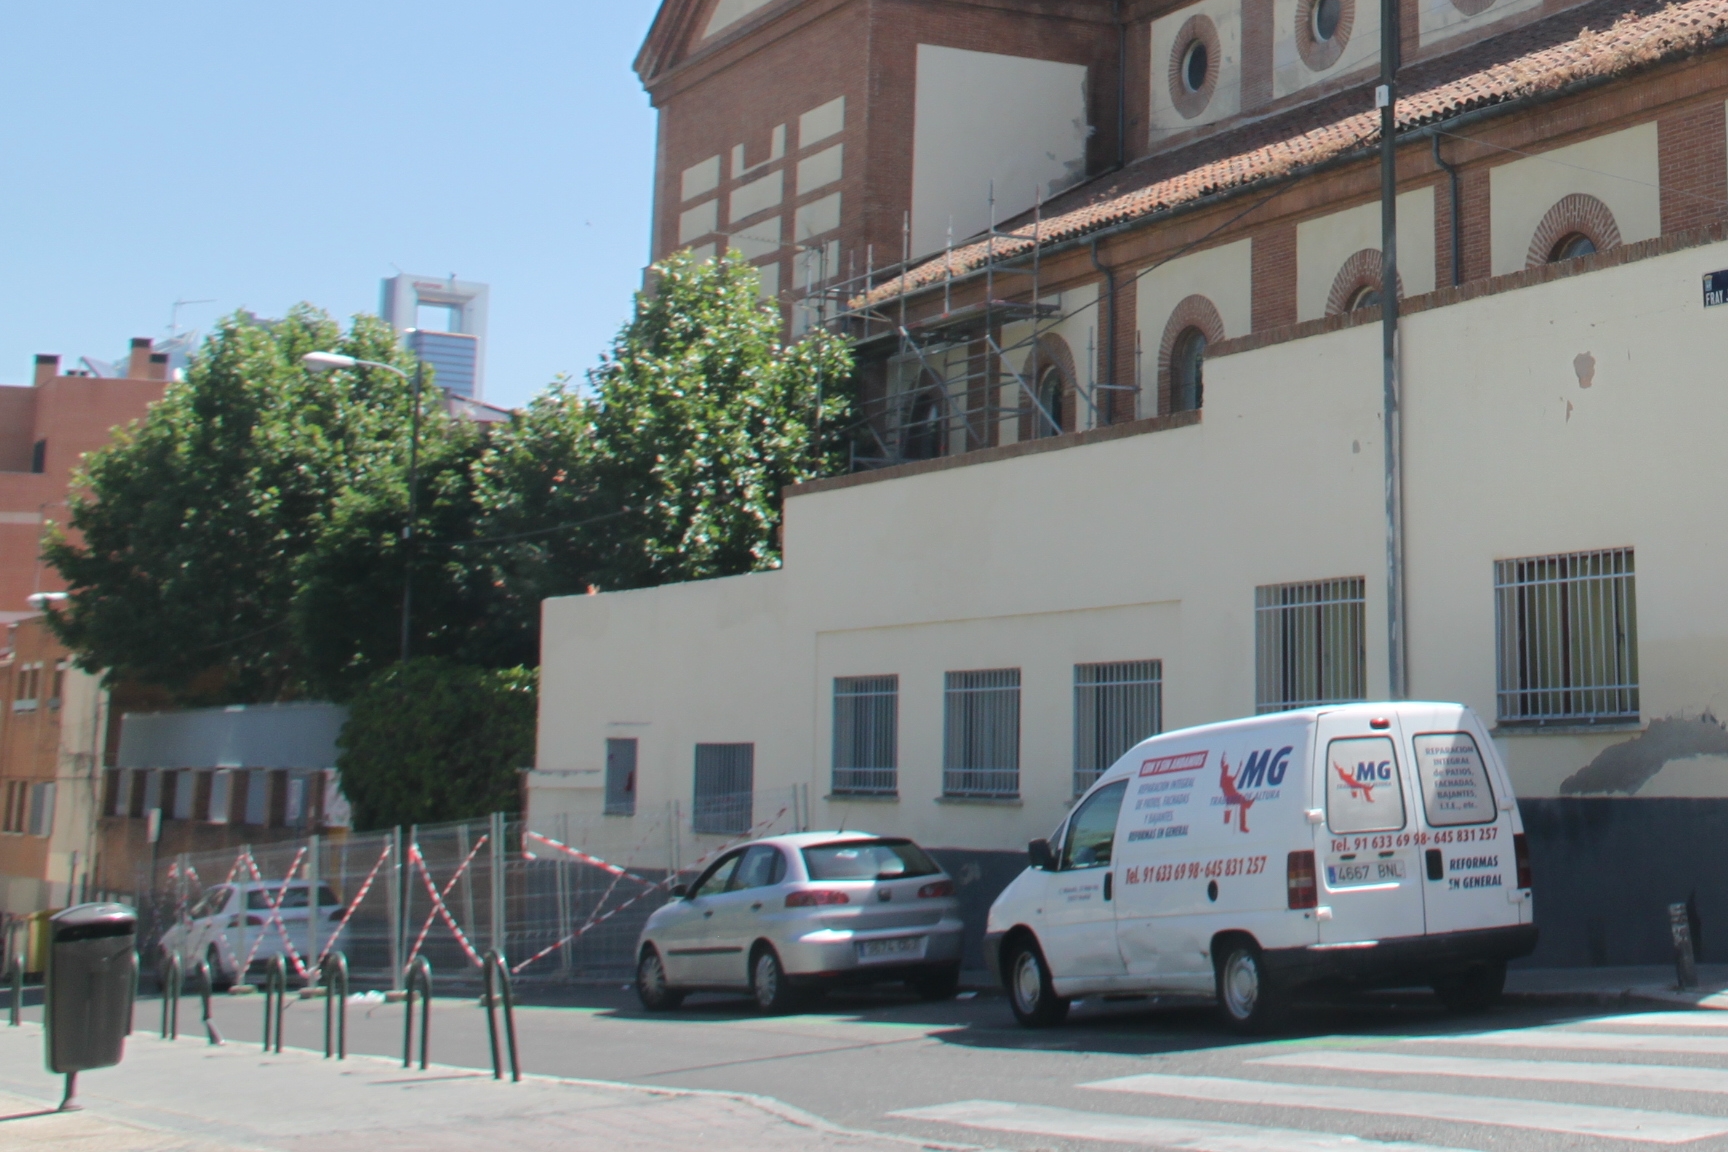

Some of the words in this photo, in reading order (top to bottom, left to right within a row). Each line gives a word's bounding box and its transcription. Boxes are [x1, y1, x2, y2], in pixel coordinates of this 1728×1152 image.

[1706, 290, 1723, 305] FRAY
[1237, 746, 1294, 789] MG
[1356, 761, 1391, 780] MG
[1331, 836, 1350, 852] Tel.
[1354, 836, 1368, 850] 91
[1371, 835, 1392, 849] 633
[1396, 833, 1410, 847] 69
[1434, 830, 1453, 844] 645
[1457, 829, 1475, 842] 831
[1479, 827, 1498, 841] 257
[1126, 866, 1139, 885] Tel.
[1143, 866, 1154, 883] 91
[1156, 864, 1173, 882] 633
[1174, 863, 1186, 880] 69
[1225, 858, 1243, 876] 831
[1246, 855, 1268, 875] 257
[1338, 865, 1369, 880] 4667
[1378, 863, 1402, 878] BNL
[1449, 855, 1498, 870] REFORMAS
[1463, 874, 1502, 889] GENERAL
